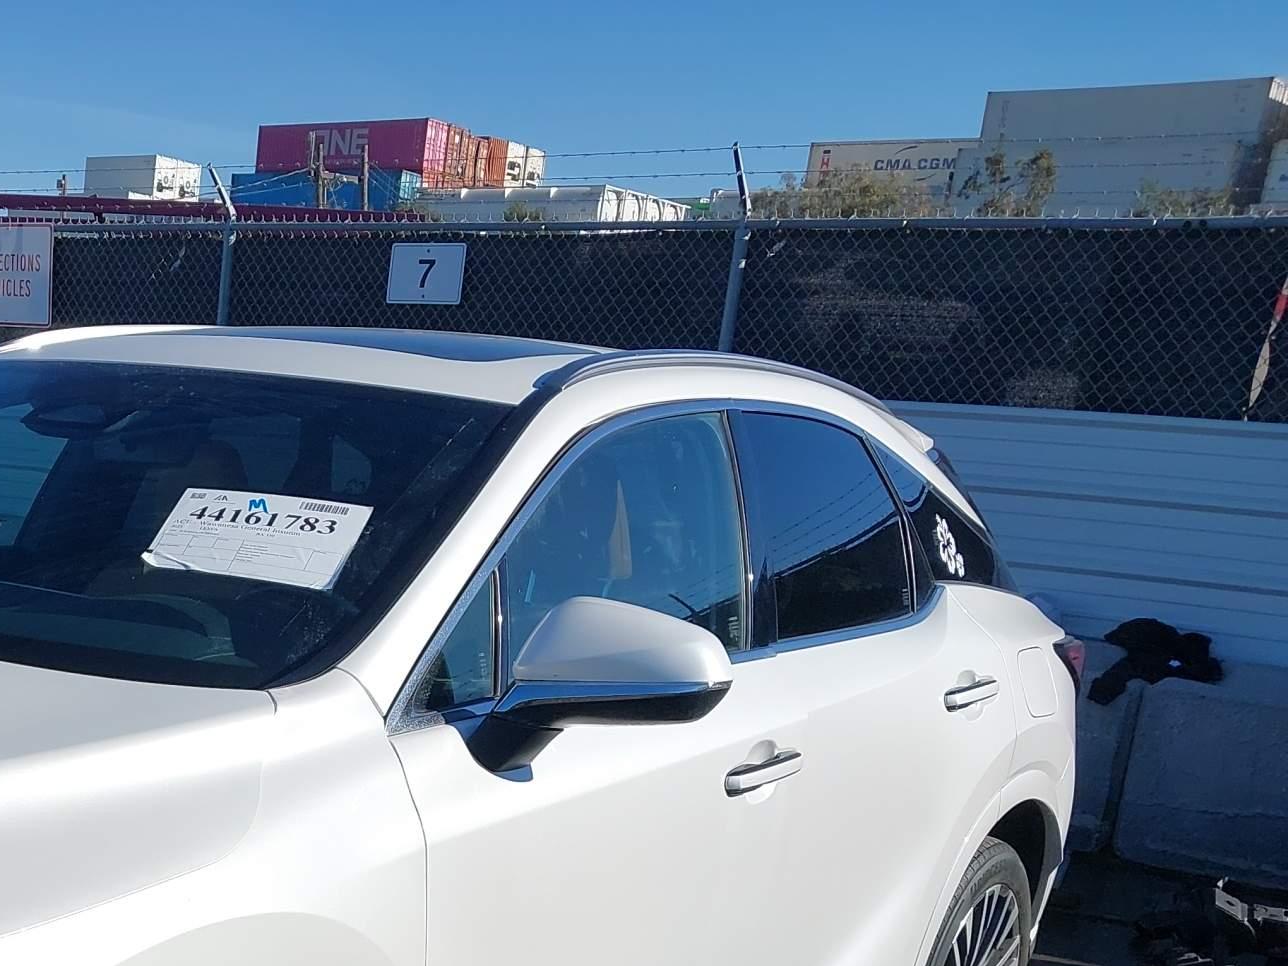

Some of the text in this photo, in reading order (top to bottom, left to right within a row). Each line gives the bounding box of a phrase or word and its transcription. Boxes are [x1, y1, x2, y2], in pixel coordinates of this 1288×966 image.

[873, 157, 957, 171] CMA CGM
[418, 258, 437, 289] 7
[189, 505, 338, 535] 44161783
